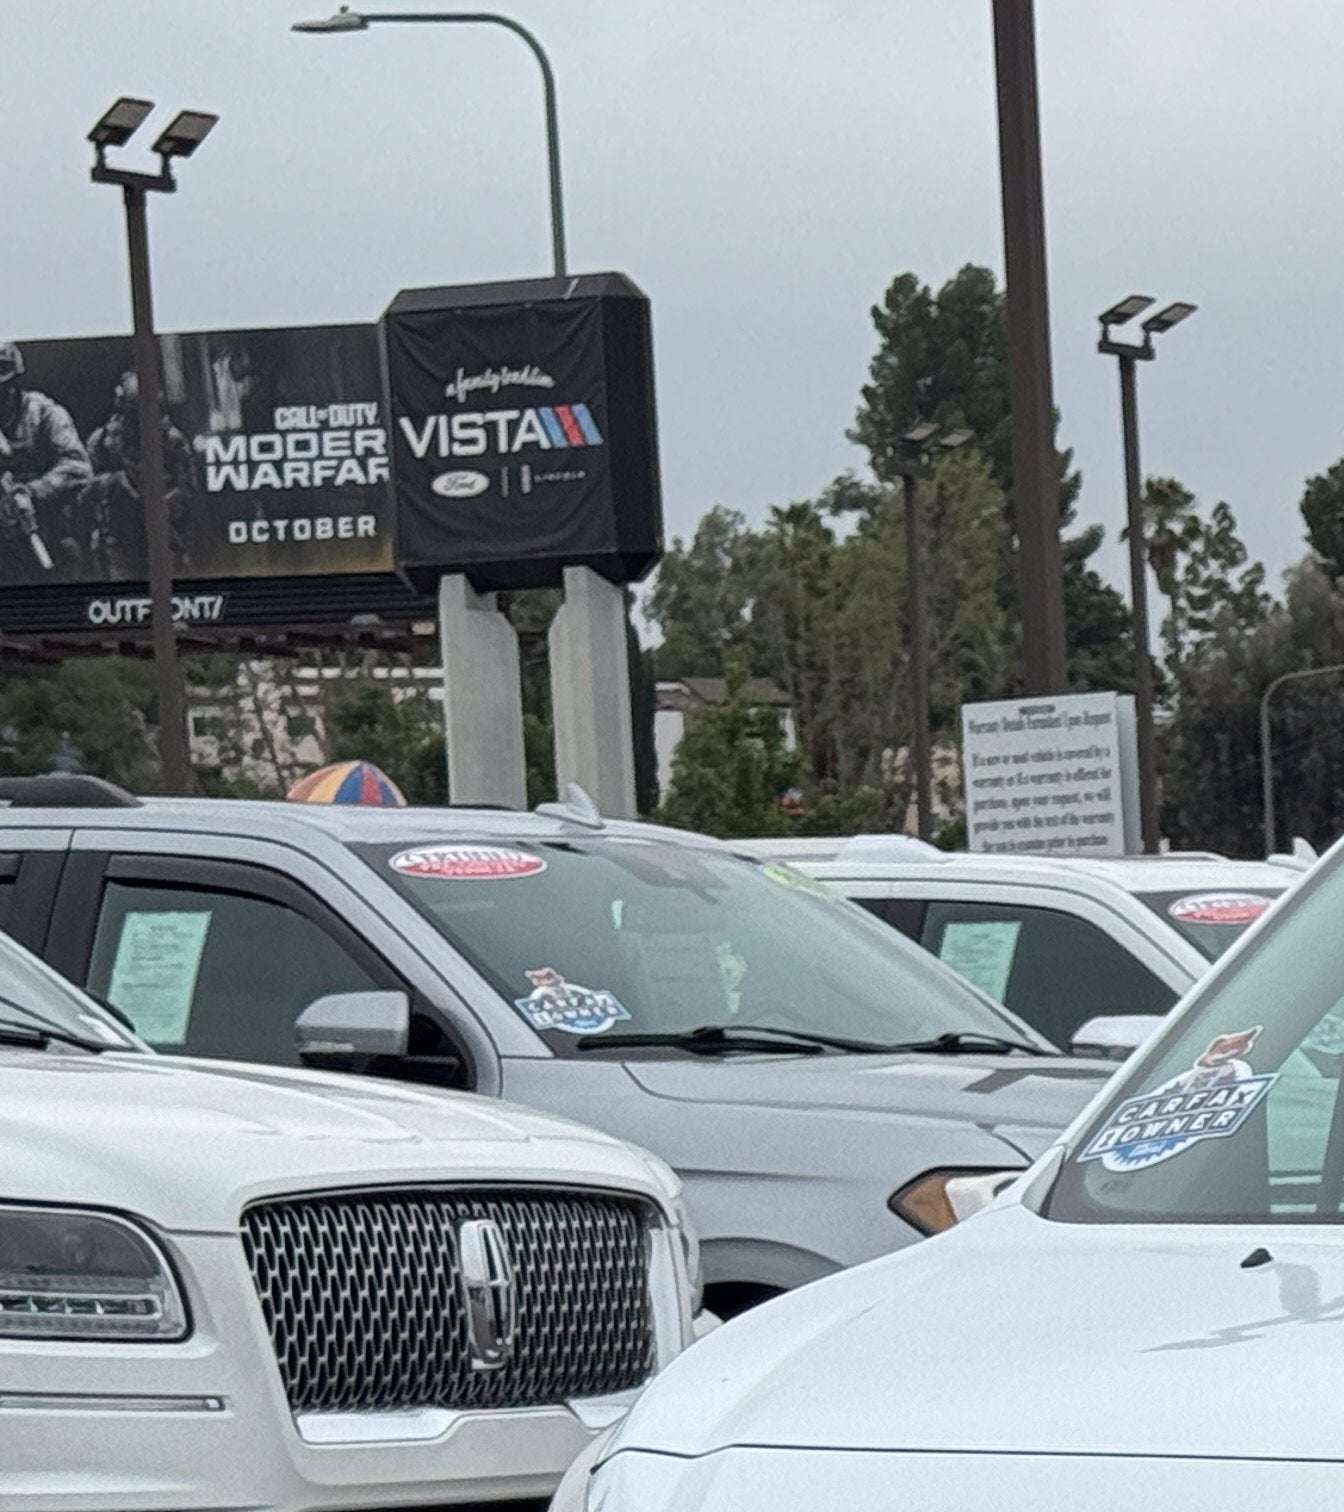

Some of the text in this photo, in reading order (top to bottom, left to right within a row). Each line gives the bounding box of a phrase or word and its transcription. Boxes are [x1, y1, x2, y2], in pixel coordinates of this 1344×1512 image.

[274, 405, 319, 430] CALL
[328, 402, 378, 428] DUTY
[399, 408, 552, 459] VISTA
[206, 428, 387, 464] MODER
[206, 456, 390, 492] WARFAR
[228, 514, 377, 544] OCTOBER
[1117, 1088, 1256, 1124] CARFAX
[1120, 1109, 1238, 1144] OWNER
